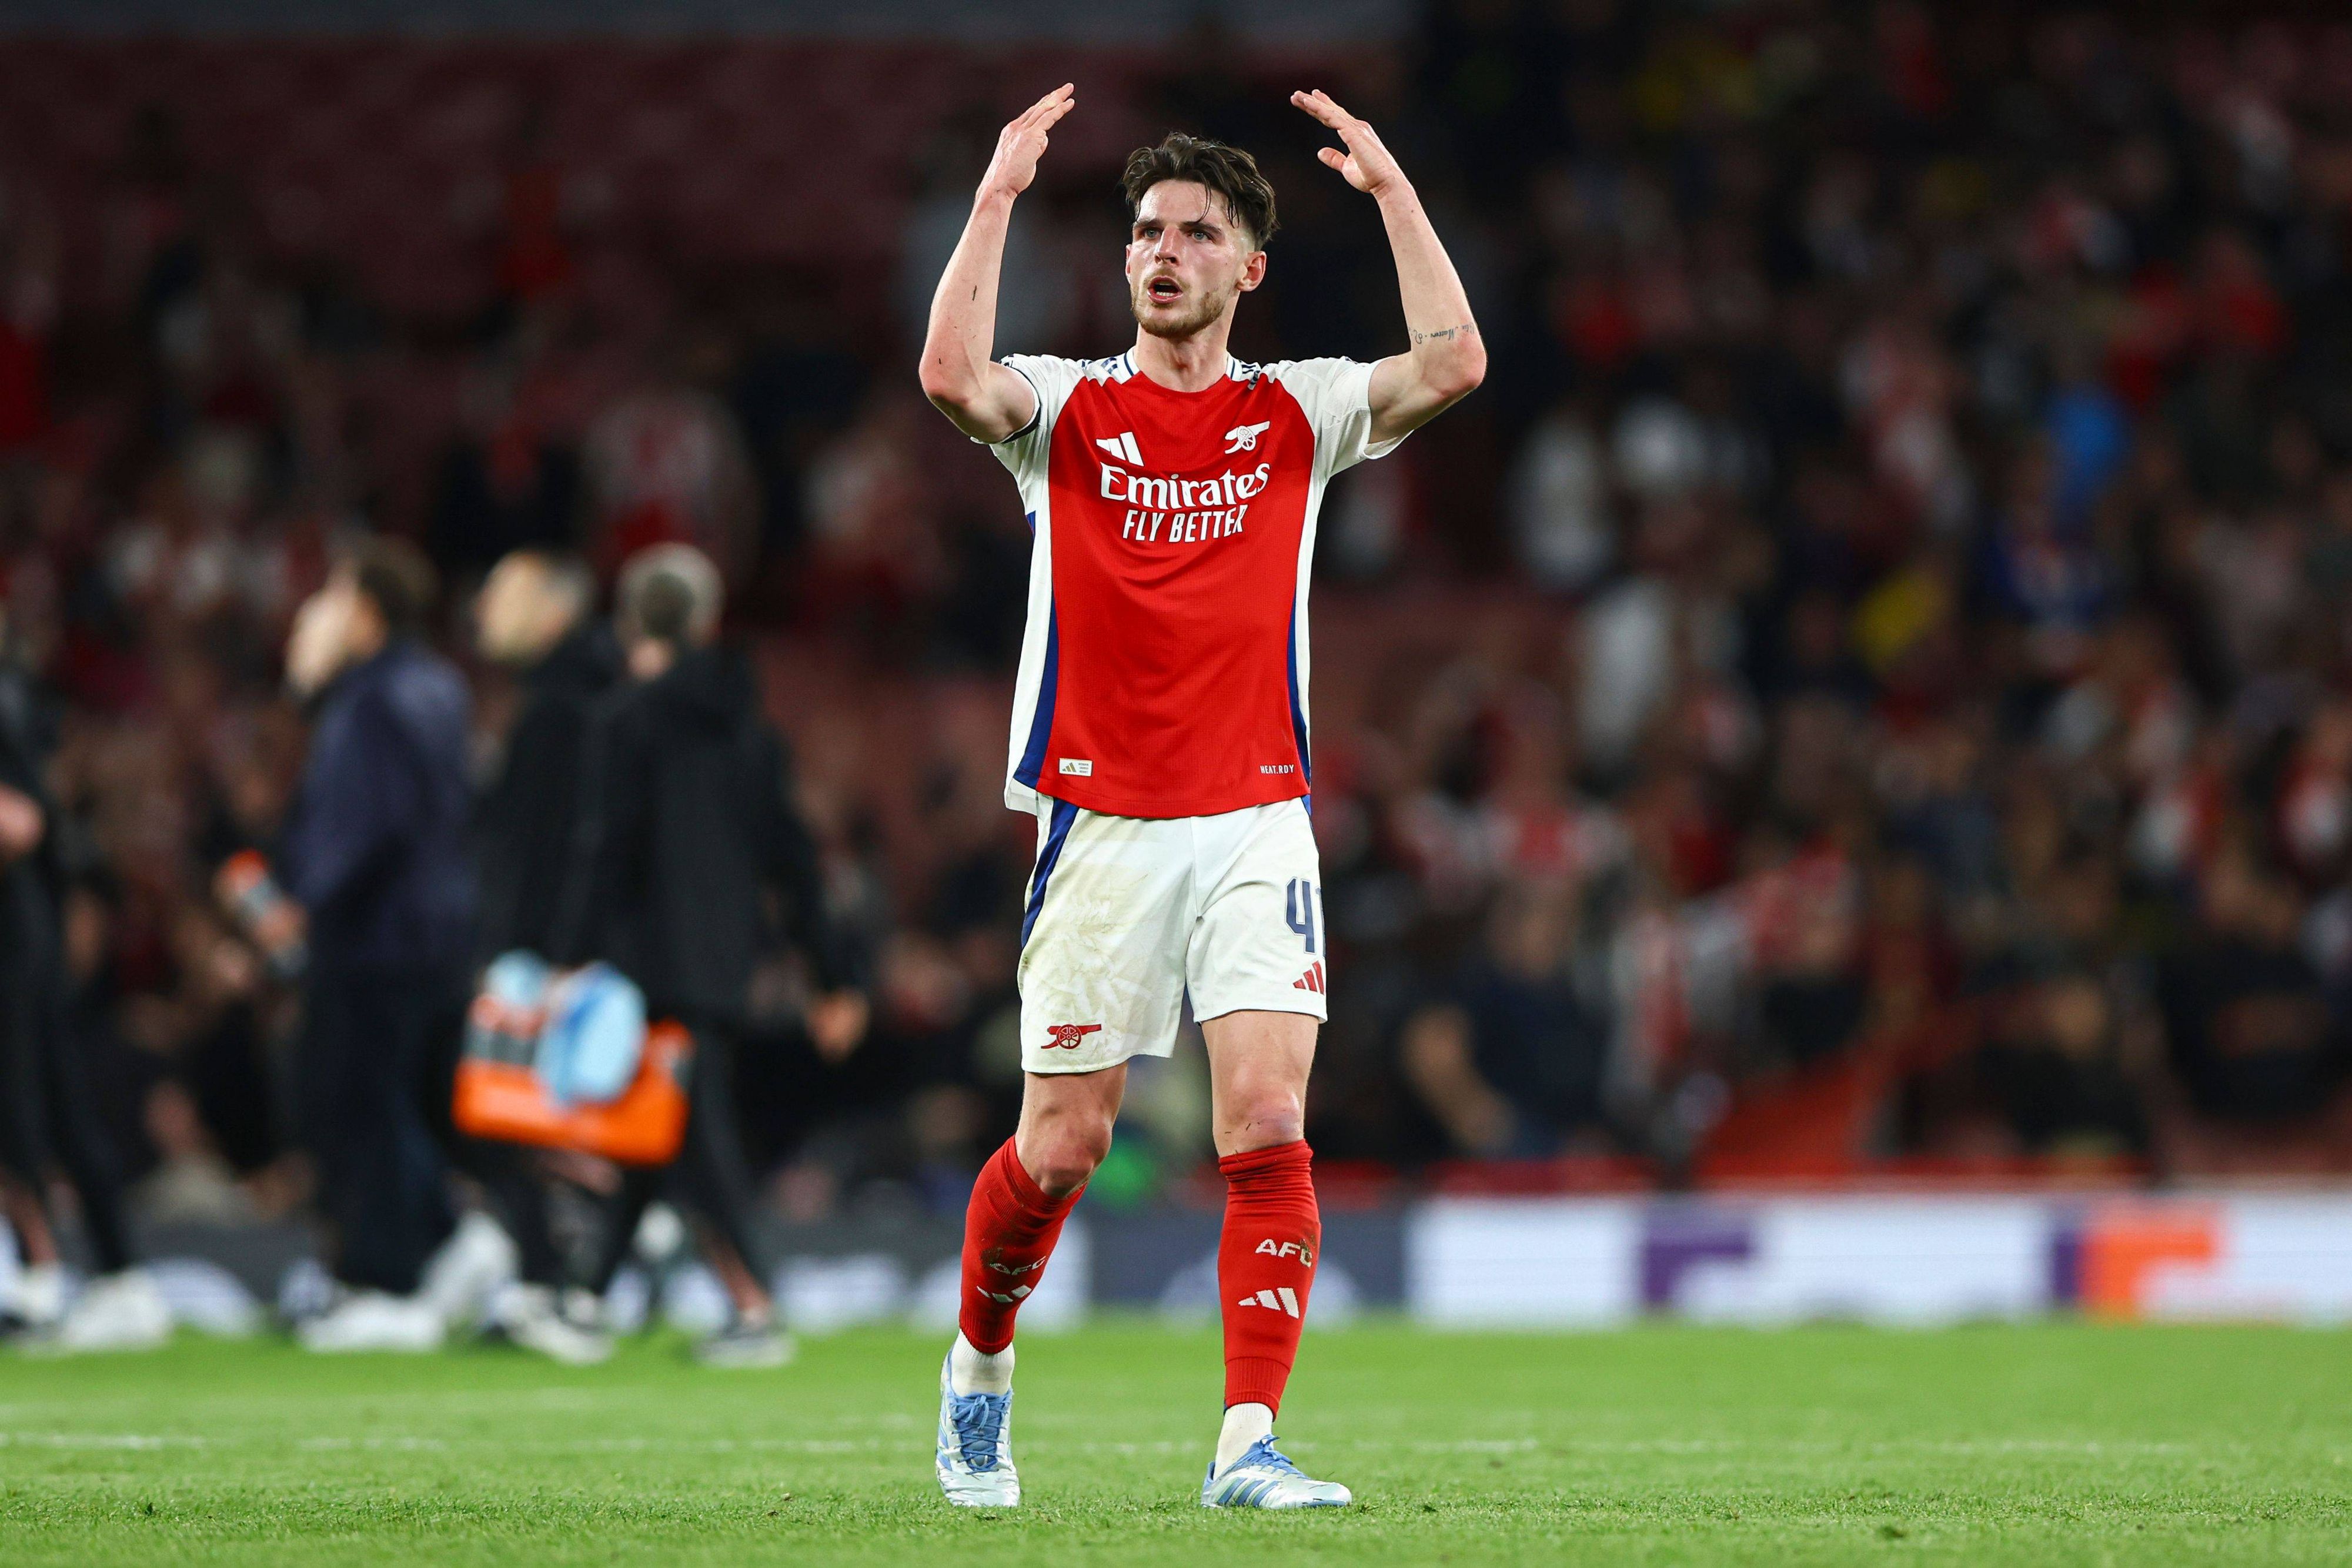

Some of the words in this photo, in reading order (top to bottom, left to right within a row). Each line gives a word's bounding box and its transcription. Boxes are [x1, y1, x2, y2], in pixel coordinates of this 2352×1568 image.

[1100, 462, 1270, 509] Emirates
[1122, 509, 1165, 541] FLY
[1168, 504, 1248, 543] BETTER
[1259, 764, 1294, 774] HEAT.RDY
[1255, 1239, 1312, 1268] AFC
